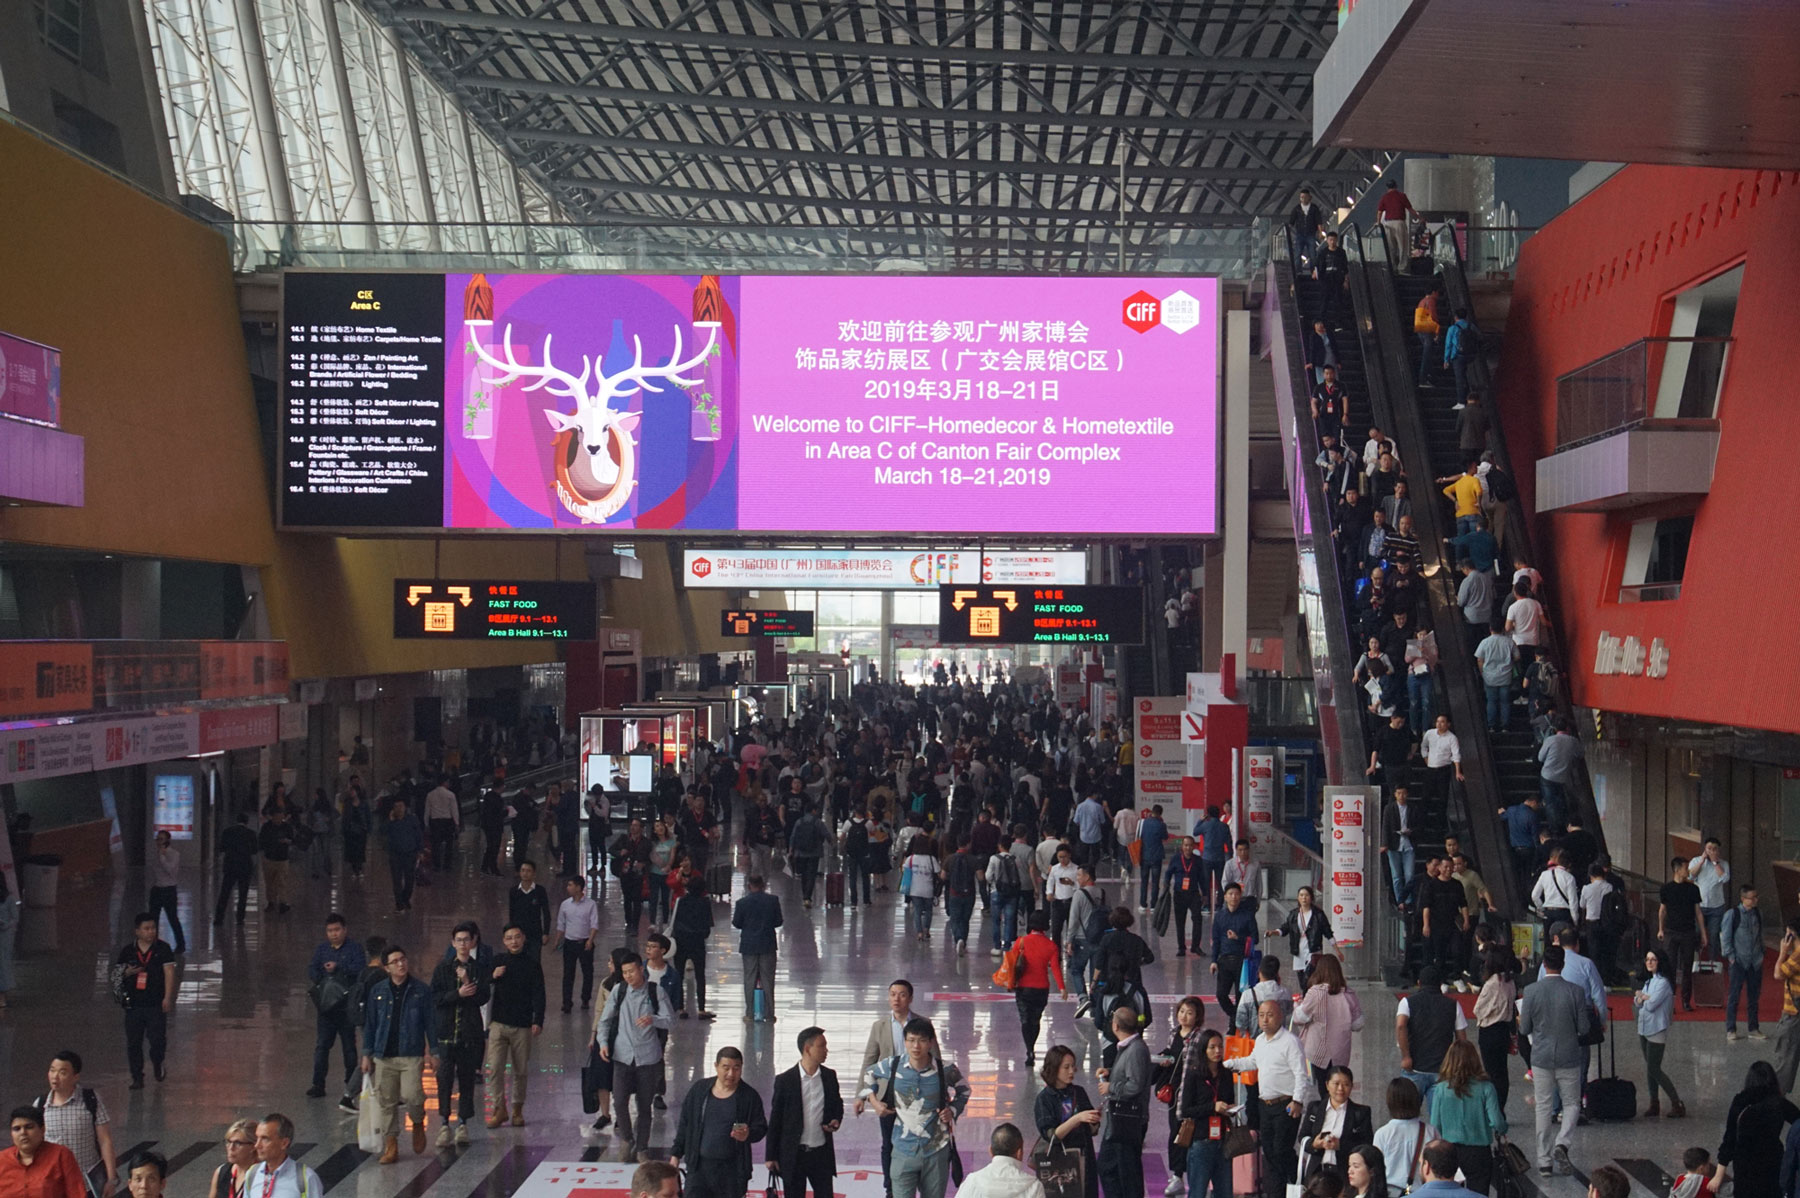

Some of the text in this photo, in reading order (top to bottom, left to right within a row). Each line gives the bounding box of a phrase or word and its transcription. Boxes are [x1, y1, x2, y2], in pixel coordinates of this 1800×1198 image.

[357, 291, 373, 299] C区
[372, 302, 381, 310] C
[1127, 303, 1156, 321] Ciff
[838, 320, 1089, 343] 欢迎前往参观广州家博会
[795, 348, 1123, 371] 饰品家纺展区（广交会展馆C区）
[362, 381, 388, 389] Lighting
[753, 415, 840, 432] Welcome
[846, 417, 863, 433] to
[1043, 417, 1056, 434] &
[1063, 417, 1173, 434] Hometextile
[806, 442, 1120, 464] in Area C of Canton Fair Complex
[875, 467, 932, 484] March
[488, 629, 508, 637] Area
[516, 629, 531, 637] Hall
[1034, 633, 1052, 641] Area
